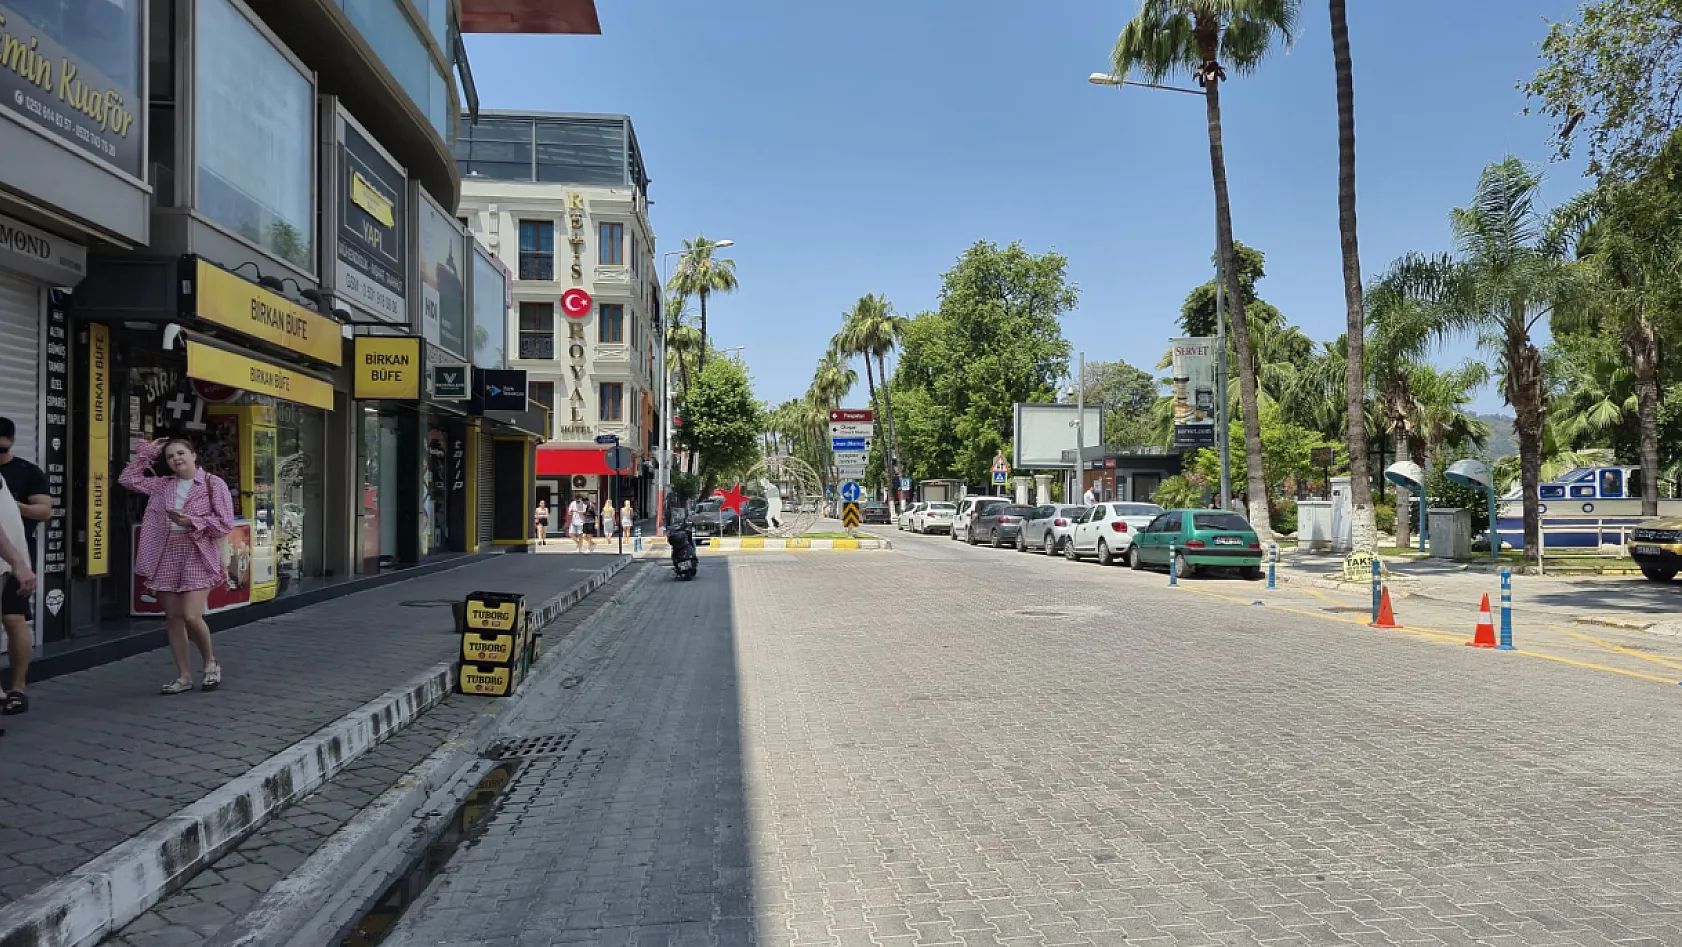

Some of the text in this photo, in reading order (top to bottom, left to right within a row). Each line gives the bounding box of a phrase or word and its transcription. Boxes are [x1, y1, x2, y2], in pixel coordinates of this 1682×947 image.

[59, 57, 133, 136] Kuaför
[251, 295, 308, 340] BİRKAN BÜFE
[365, 351, 410, 366] BİRKAN
[1175, 346, 1209, 356] SERVET
[94, 333, 104, 422] BİRKAN BÜFE
[250, 366, 290, 392] BİRKAN BÜFE
[371, 368, 403, 382] BÜFE
[568, 322, 585, 422] ROYAL
[560, 426, 592, 434] HOTEL
[94, 472, 104, 560] BİRKAN BÜFE
[472, 610, 510, 620] TUBORG
[469, 642, 506, 654] TUBORG
[466, 674, 502, 686] TUBORG
